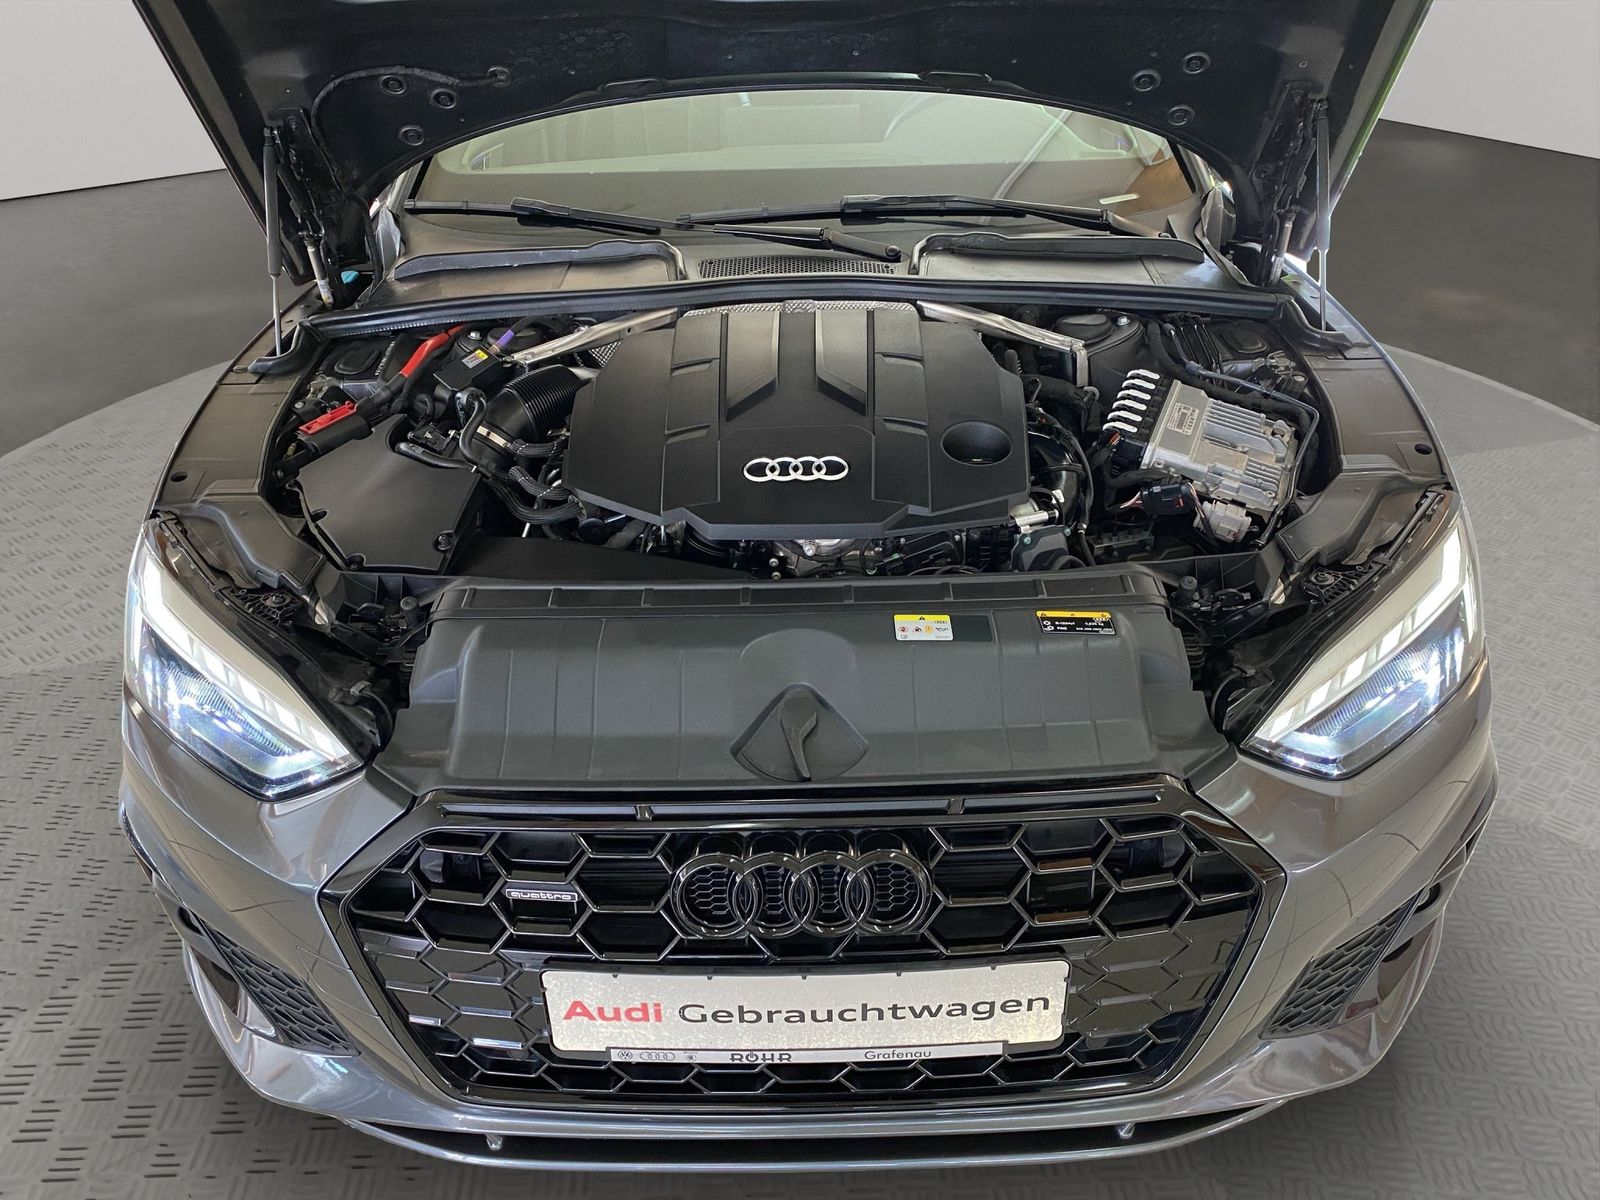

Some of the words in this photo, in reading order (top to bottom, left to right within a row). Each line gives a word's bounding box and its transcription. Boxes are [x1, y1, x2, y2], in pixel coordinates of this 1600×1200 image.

[510, 891, 572, 900] quattro
[563, 1000, 663, 1023] Audi
[678, 995, 1050, 1024] Gebrauchtwagen
[864, 1049, 932, 1060] Grafenau
